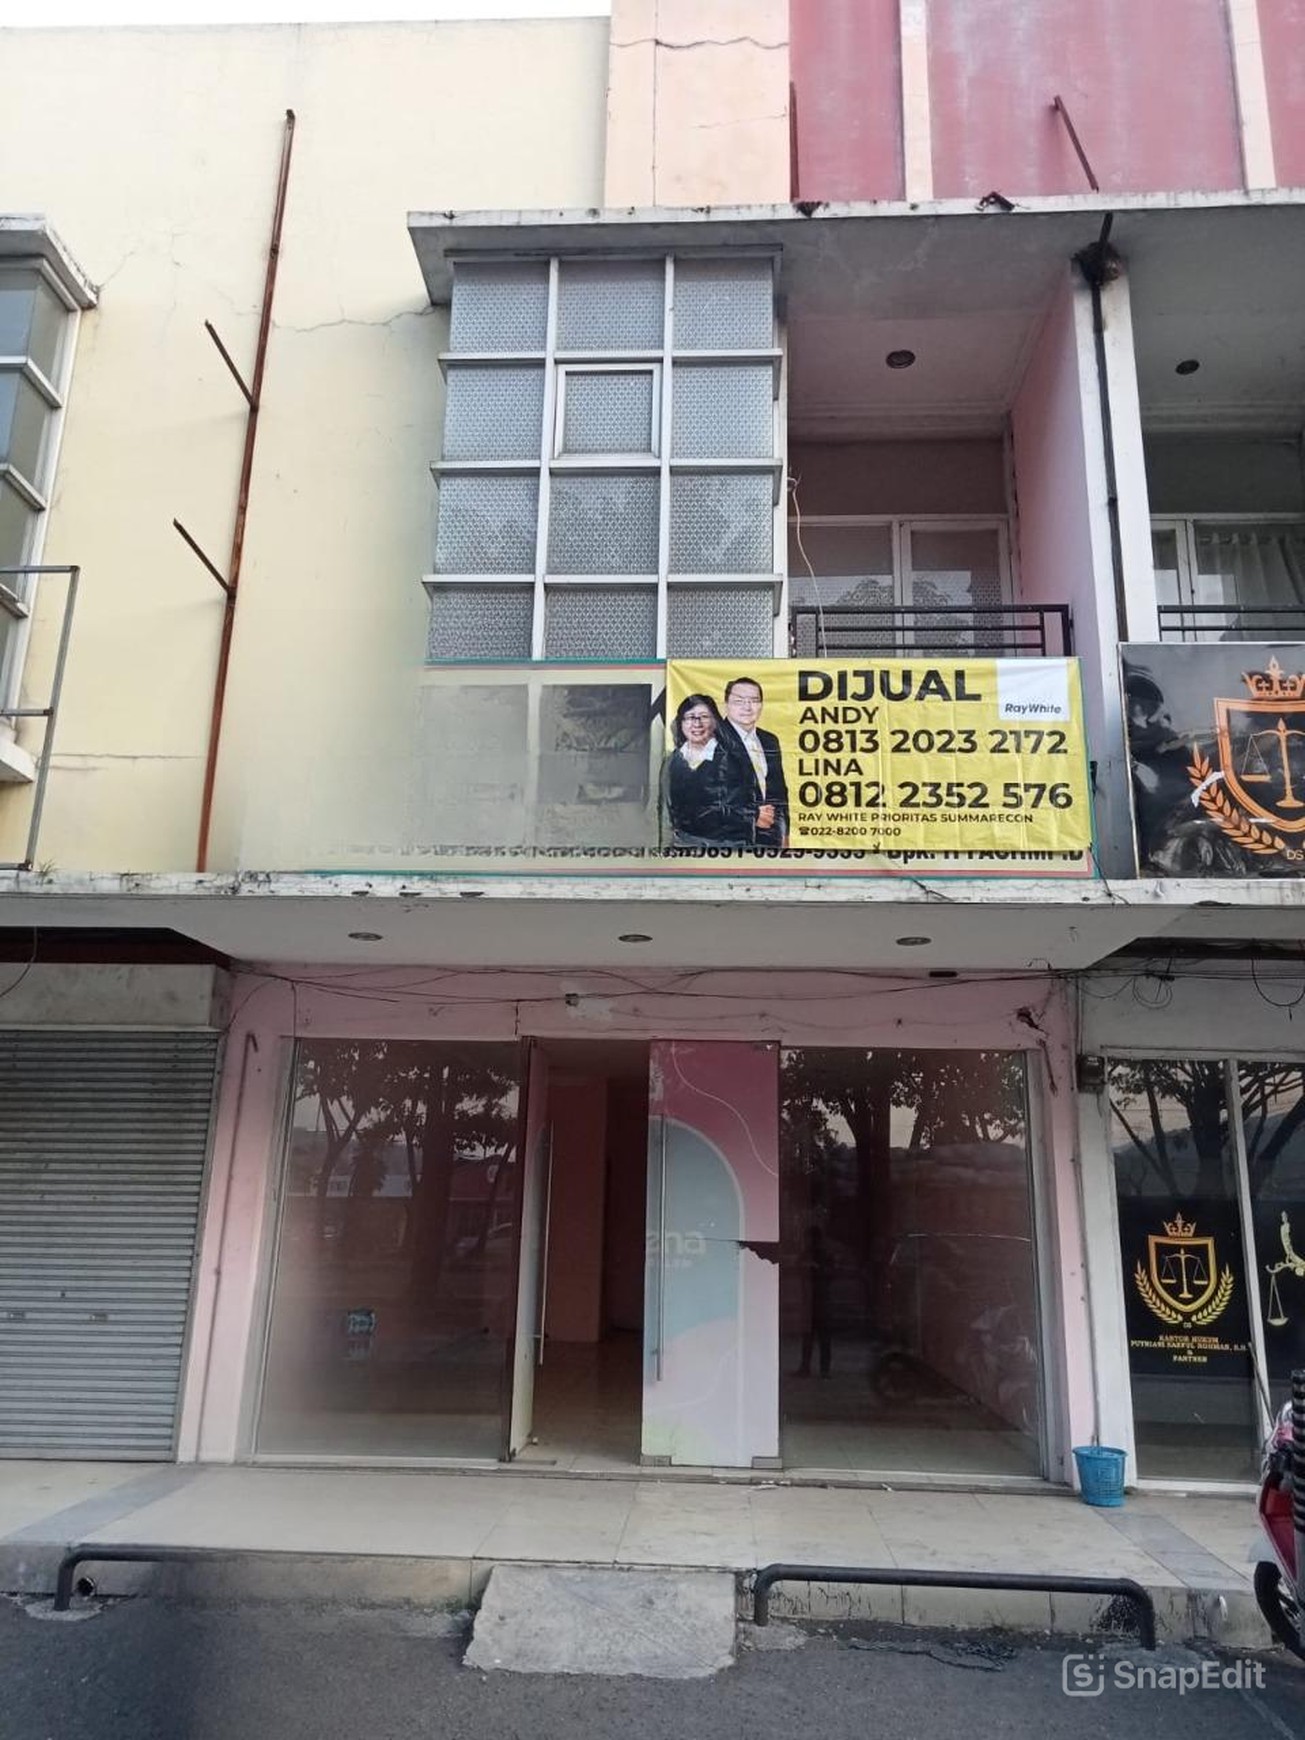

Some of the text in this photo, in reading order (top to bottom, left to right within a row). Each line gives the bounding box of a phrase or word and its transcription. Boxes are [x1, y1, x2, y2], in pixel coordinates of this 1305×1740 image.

[798, 669, 982, 702] DIJUAL
[799, 706, 879, 724] ANDY
[799, 729, 1068, 754] 0813 2023 2172
[798, 758, 863, 776] LINA
[799, 780, 1073, 809] 0812 2352 576
[798, 812, 1034, 824] RAY WHITE PRIORITAS SUMMARECON
[810, 826, 867, 836] 022-8200
